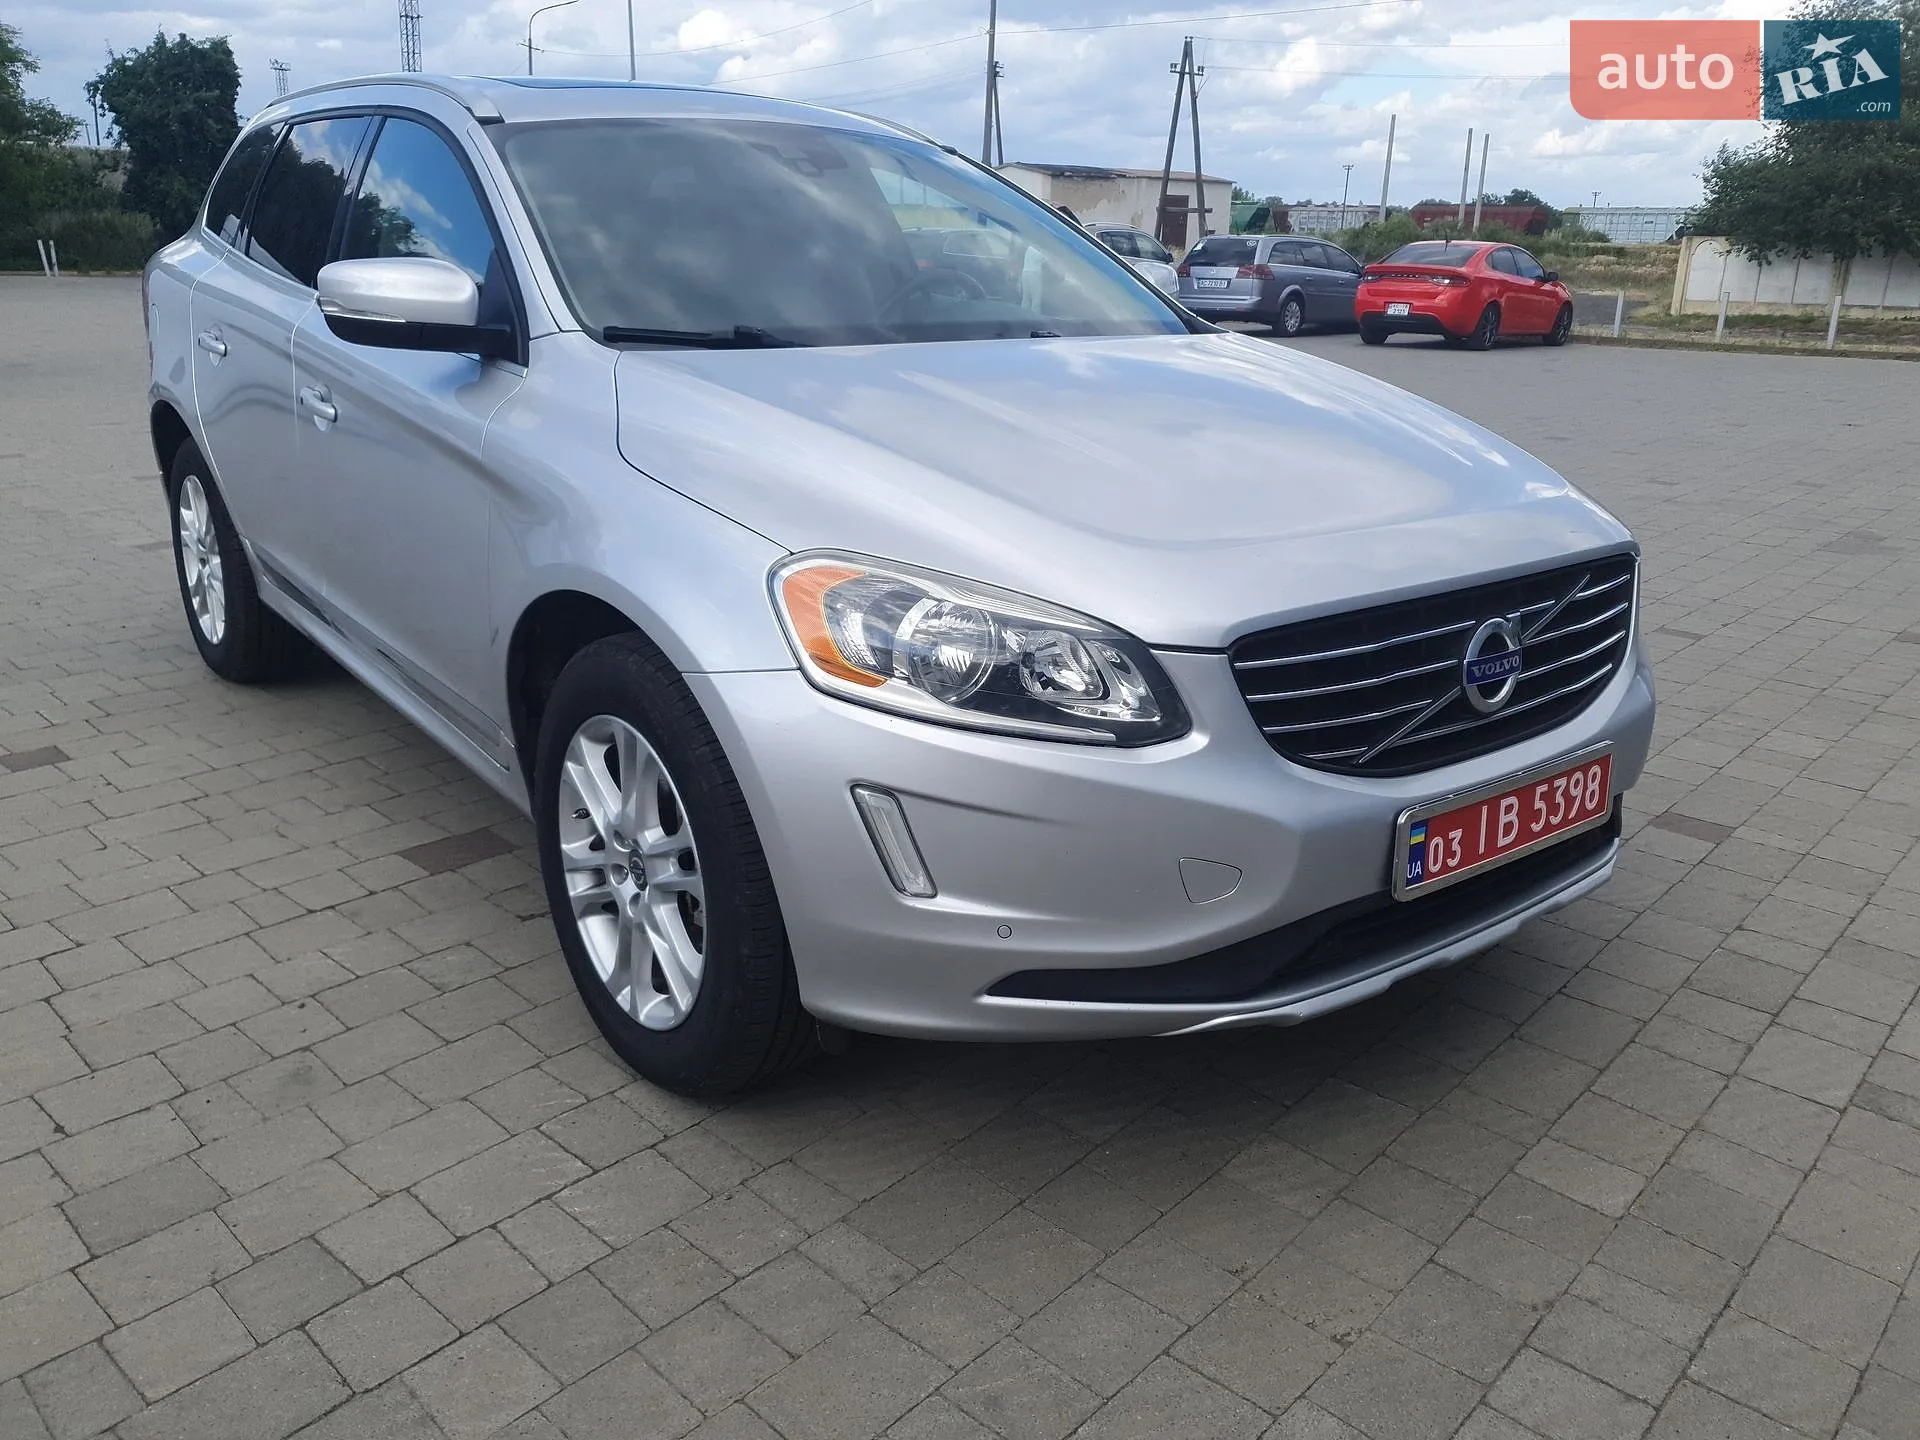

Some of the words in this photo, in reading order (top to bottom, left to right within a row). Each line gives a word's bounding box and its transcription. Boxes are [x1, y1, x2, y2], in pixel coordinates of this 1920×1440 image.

[1470, 655, 1520, 678] VOLVO
[1428, 828, 1463, 873] 03
[1478, 796, 1520, 855] IB
[1530, 764, 1602, 833] 5398
[1406, 860, 1422, 879] UA
